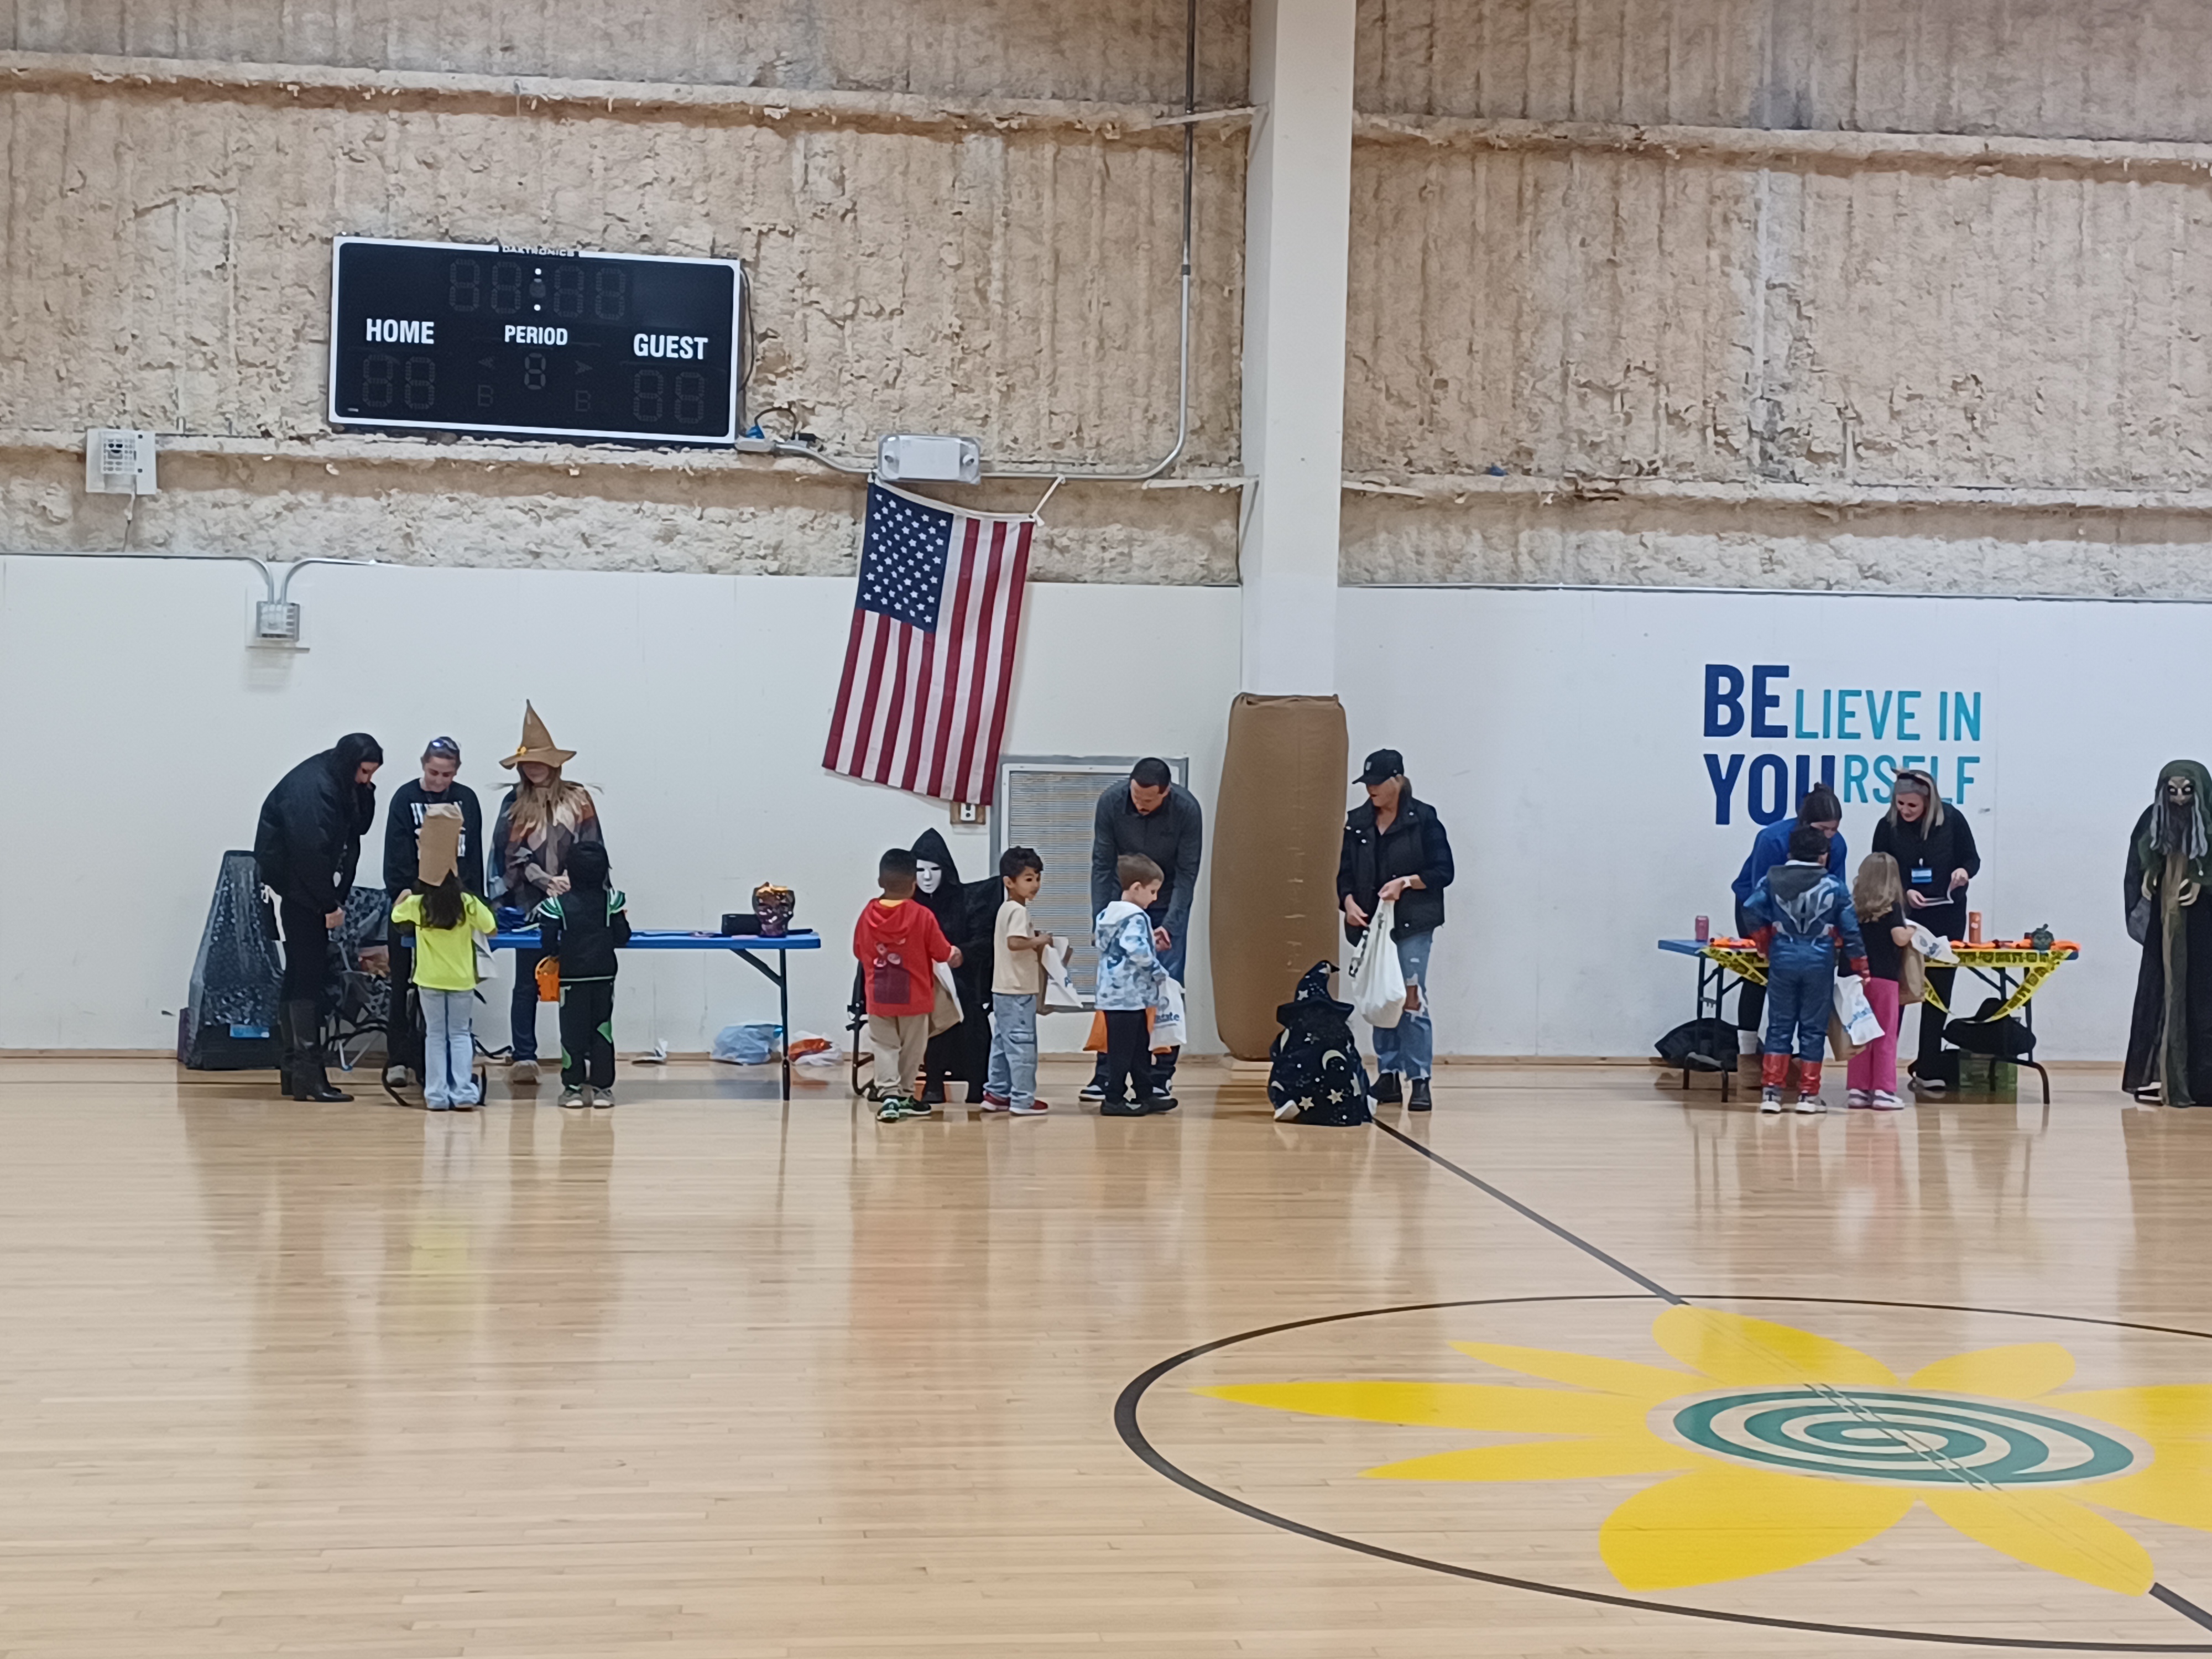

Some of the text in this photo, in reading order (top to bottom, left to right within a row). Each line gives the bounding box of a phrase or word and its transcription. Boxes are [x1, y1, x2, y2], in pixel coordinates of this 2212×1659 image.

[366, 318, 435, 345] HOME
[504, 325, 568, 346] PERIOD
[633, 333, 708, 359] GUEST
[1939, 691, 1981, 741] IN
